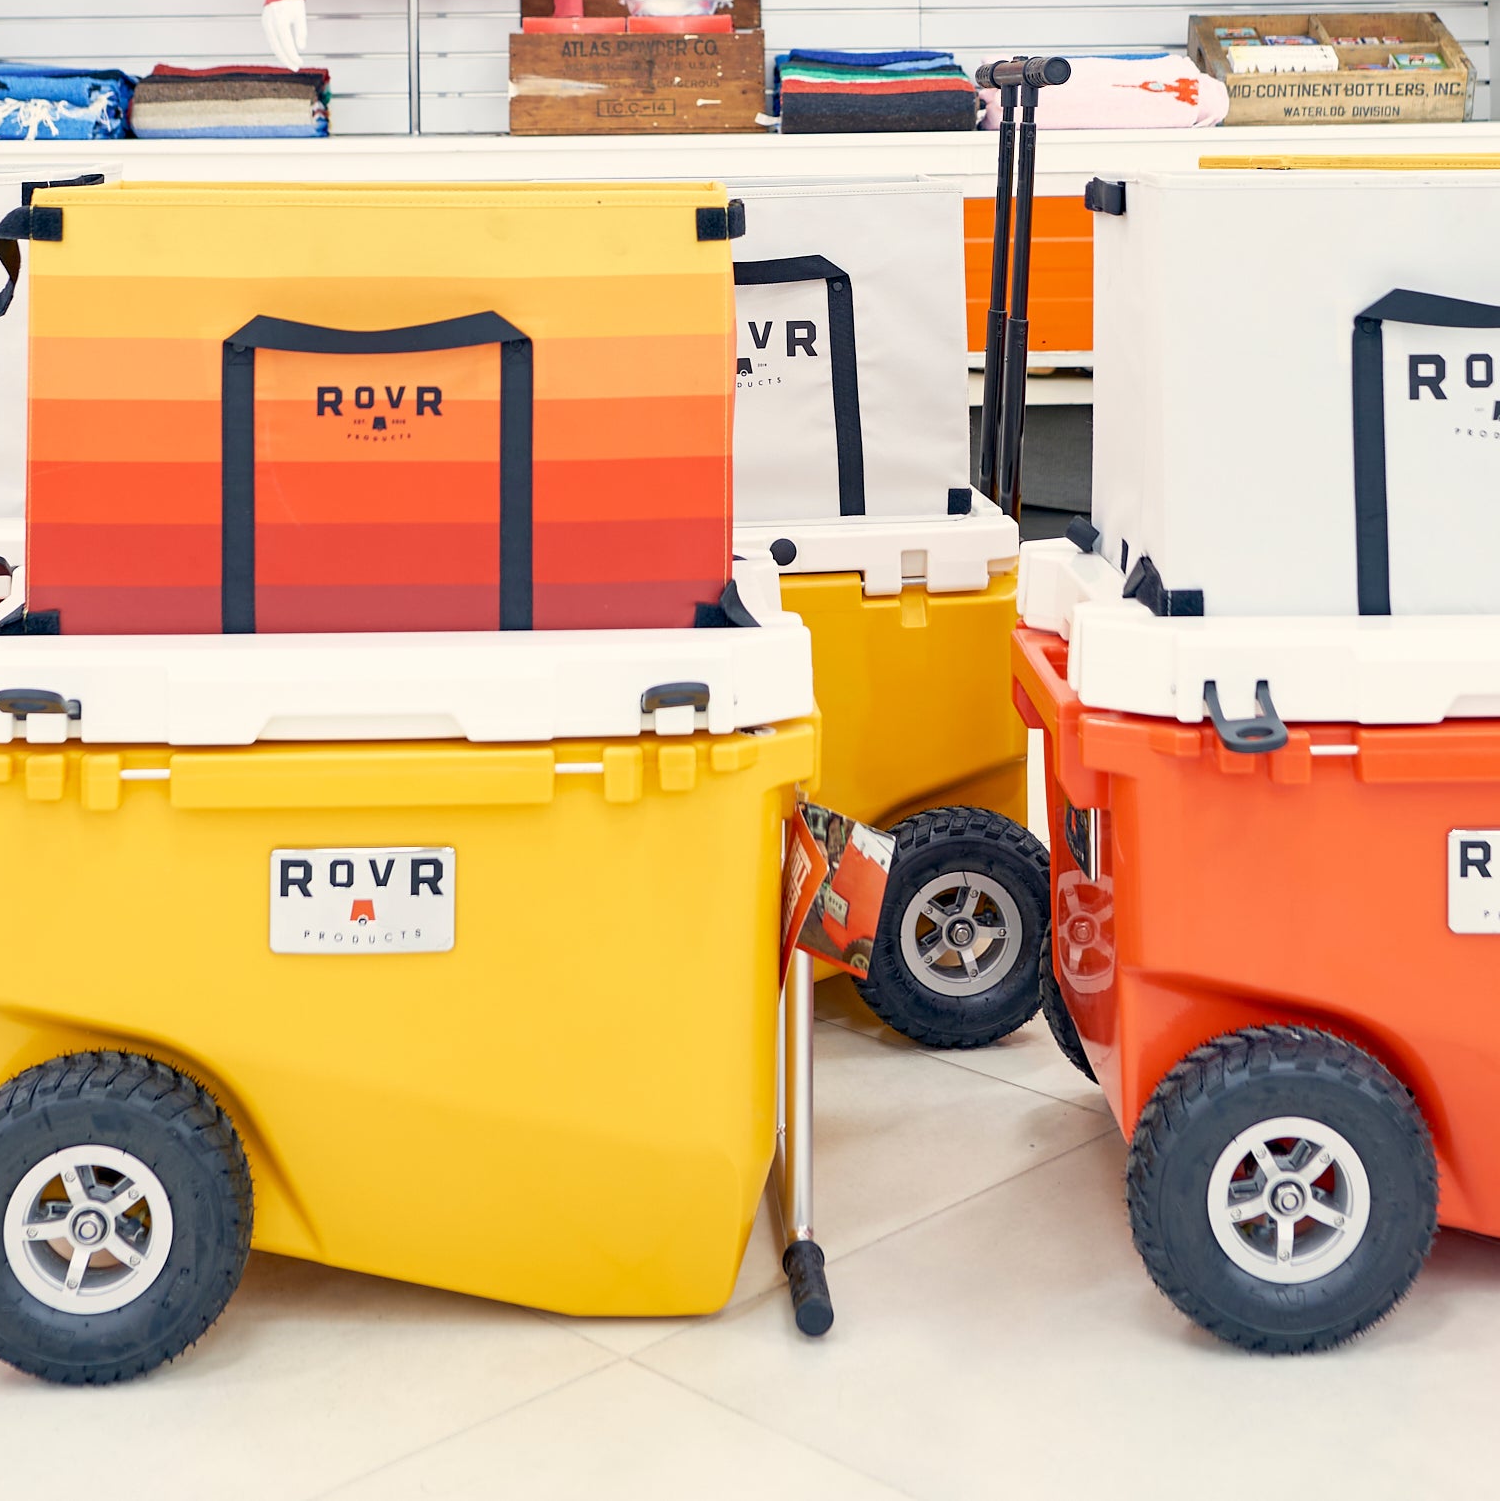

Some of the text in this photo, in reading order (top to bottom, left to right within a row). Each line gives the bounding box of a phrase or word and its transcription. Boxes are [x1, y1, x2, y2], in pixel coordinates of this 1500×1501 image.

[562, 40, 611, 58] ATLAS
[617, 40, 687, 57] POWDER
[1433, 82, 1465, 97] INC.
[1352, 105, 1401, 117] DIVISION
[747, 320, 819, 359] VR
[317, 386, 443, 417] ROVR
[346, 430, 413, 444] PRODUCTS
[280, 857, 444, 897] ROVR
[303, 929, 422, 945] PRODUCTS
